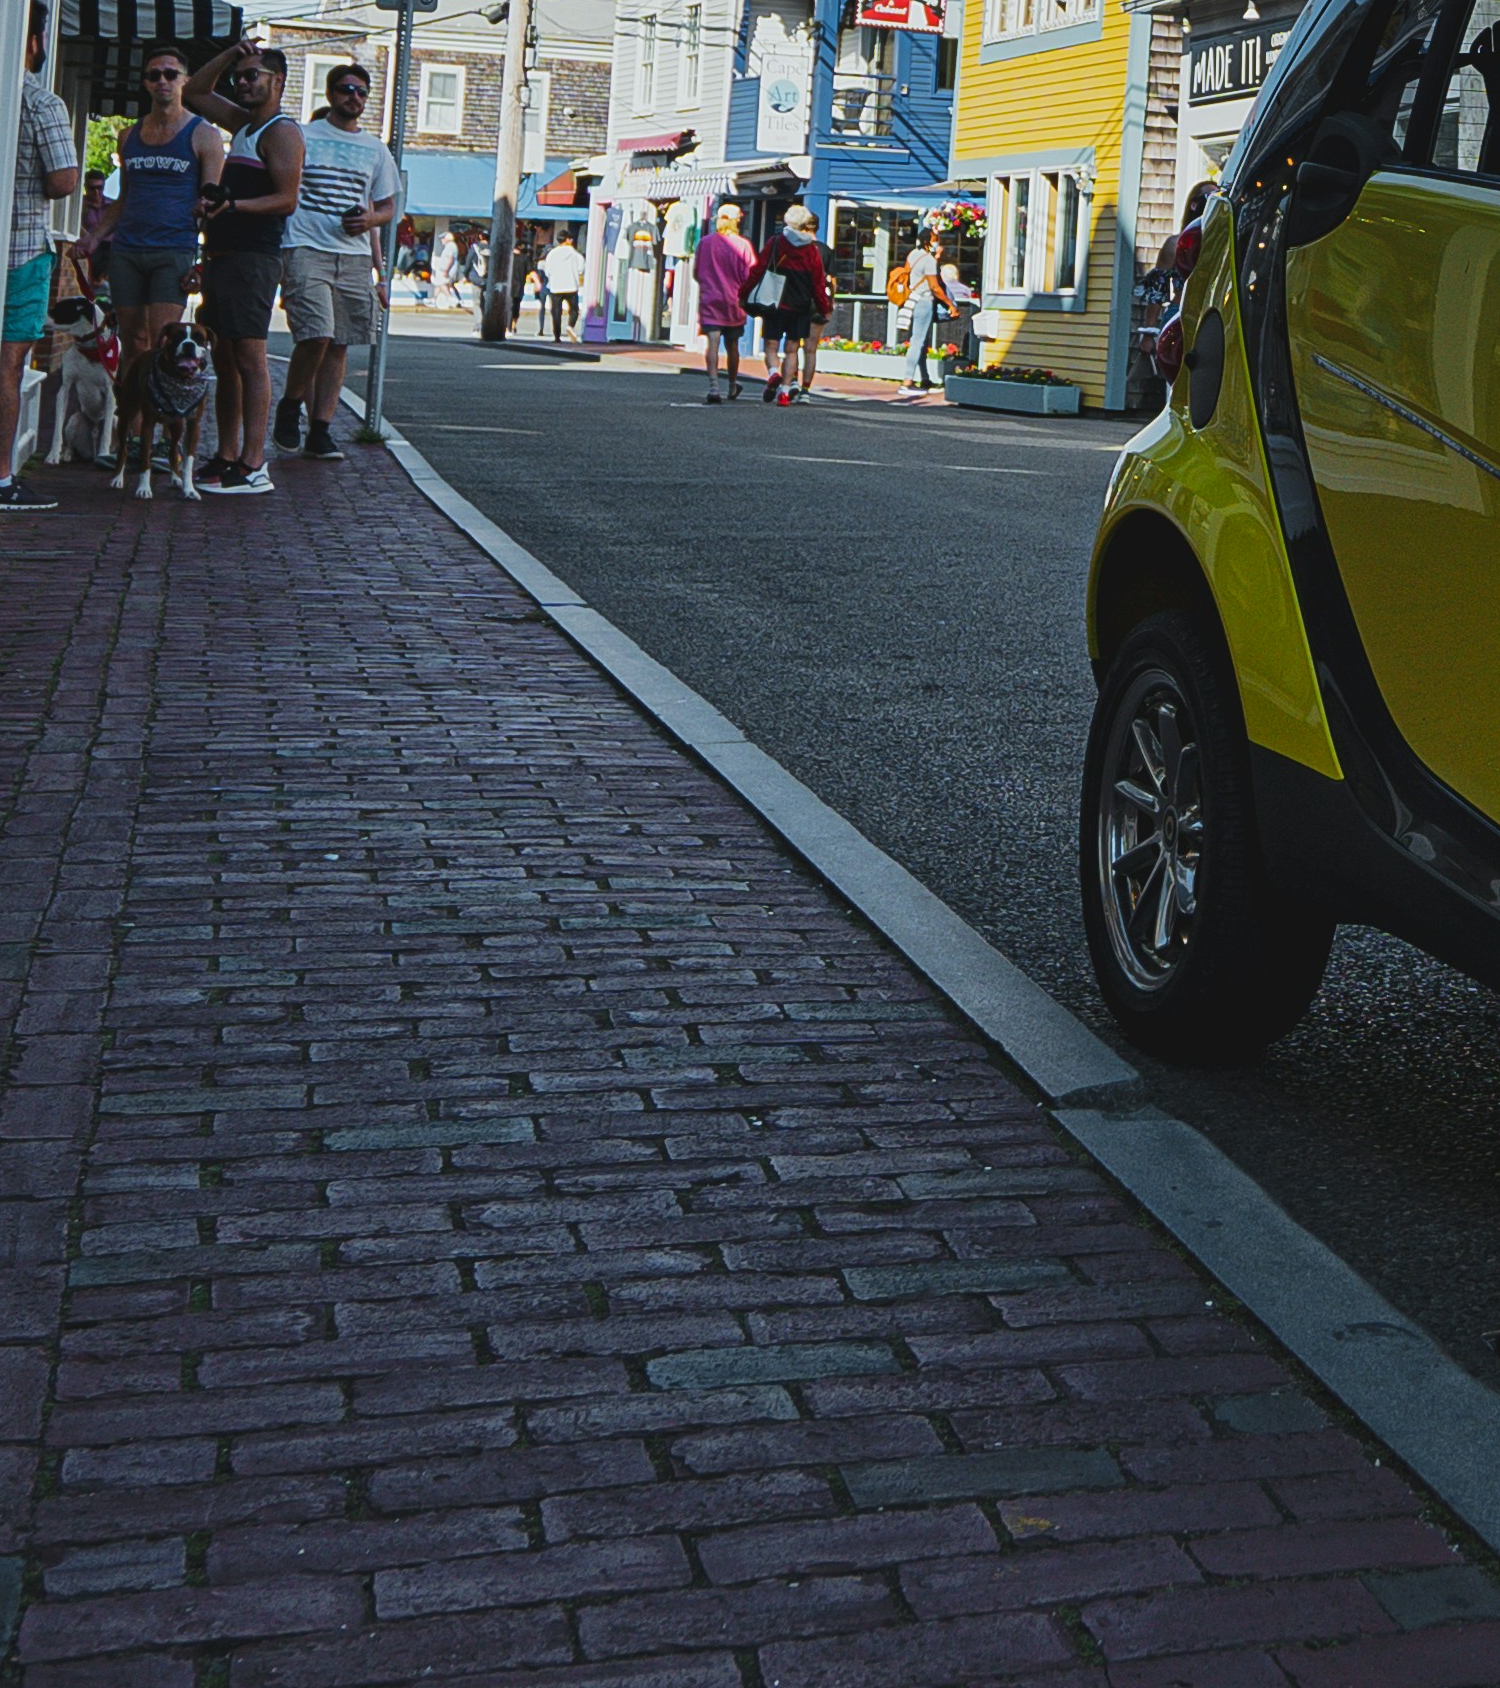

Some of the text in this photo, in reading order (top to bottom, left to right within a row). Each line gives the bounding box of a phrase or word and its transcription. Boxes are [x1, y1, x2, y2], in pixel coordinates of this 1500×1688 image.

[766, 59, 804, 79] Cape
[1193, 36, 1261, 95] MADE IT!
[768, 85, 798, 103] Art
[764, 115, 799, 131] Tiles
